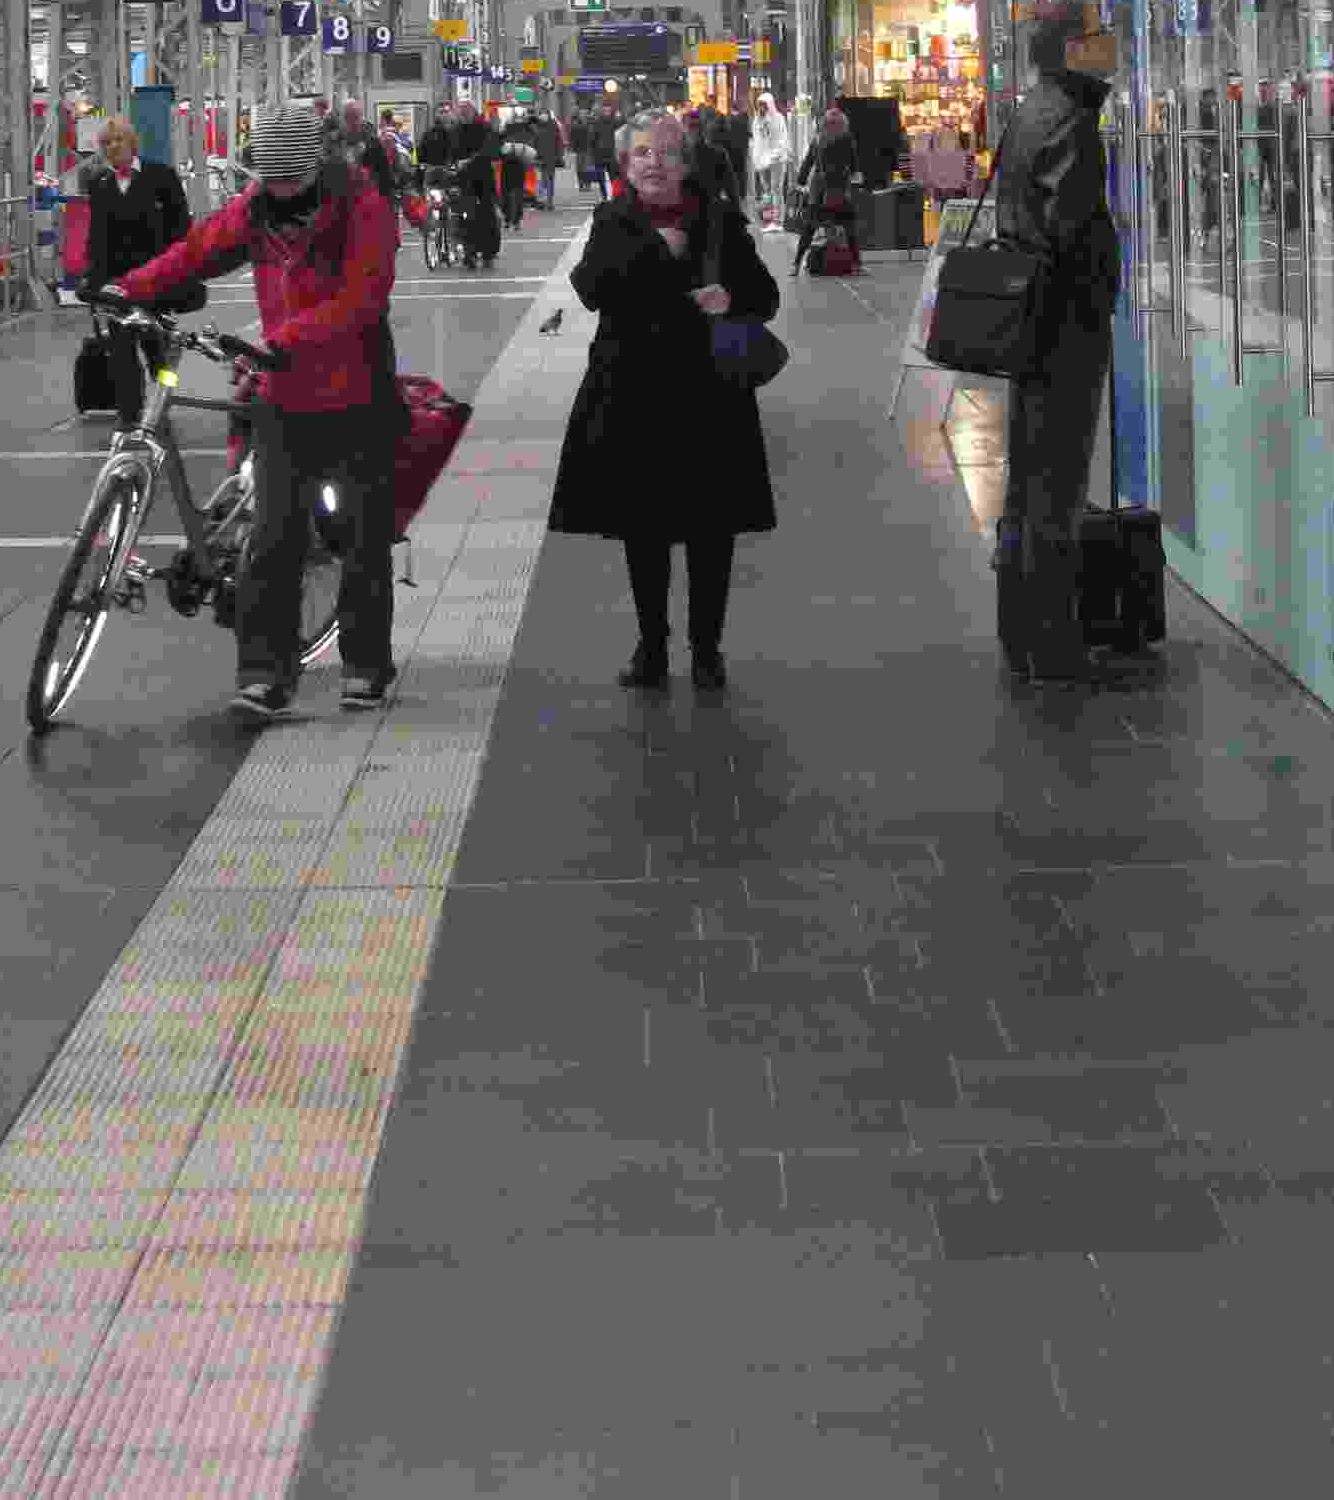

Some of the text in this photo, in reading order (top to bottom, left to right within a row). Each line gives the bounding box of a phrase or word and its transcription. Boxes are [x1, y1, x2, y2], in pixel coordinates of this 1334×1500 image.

[295, 3, 311, 28] 7
[331, 18, 350, 41] 8
[375, 26, 392, 49] 9
